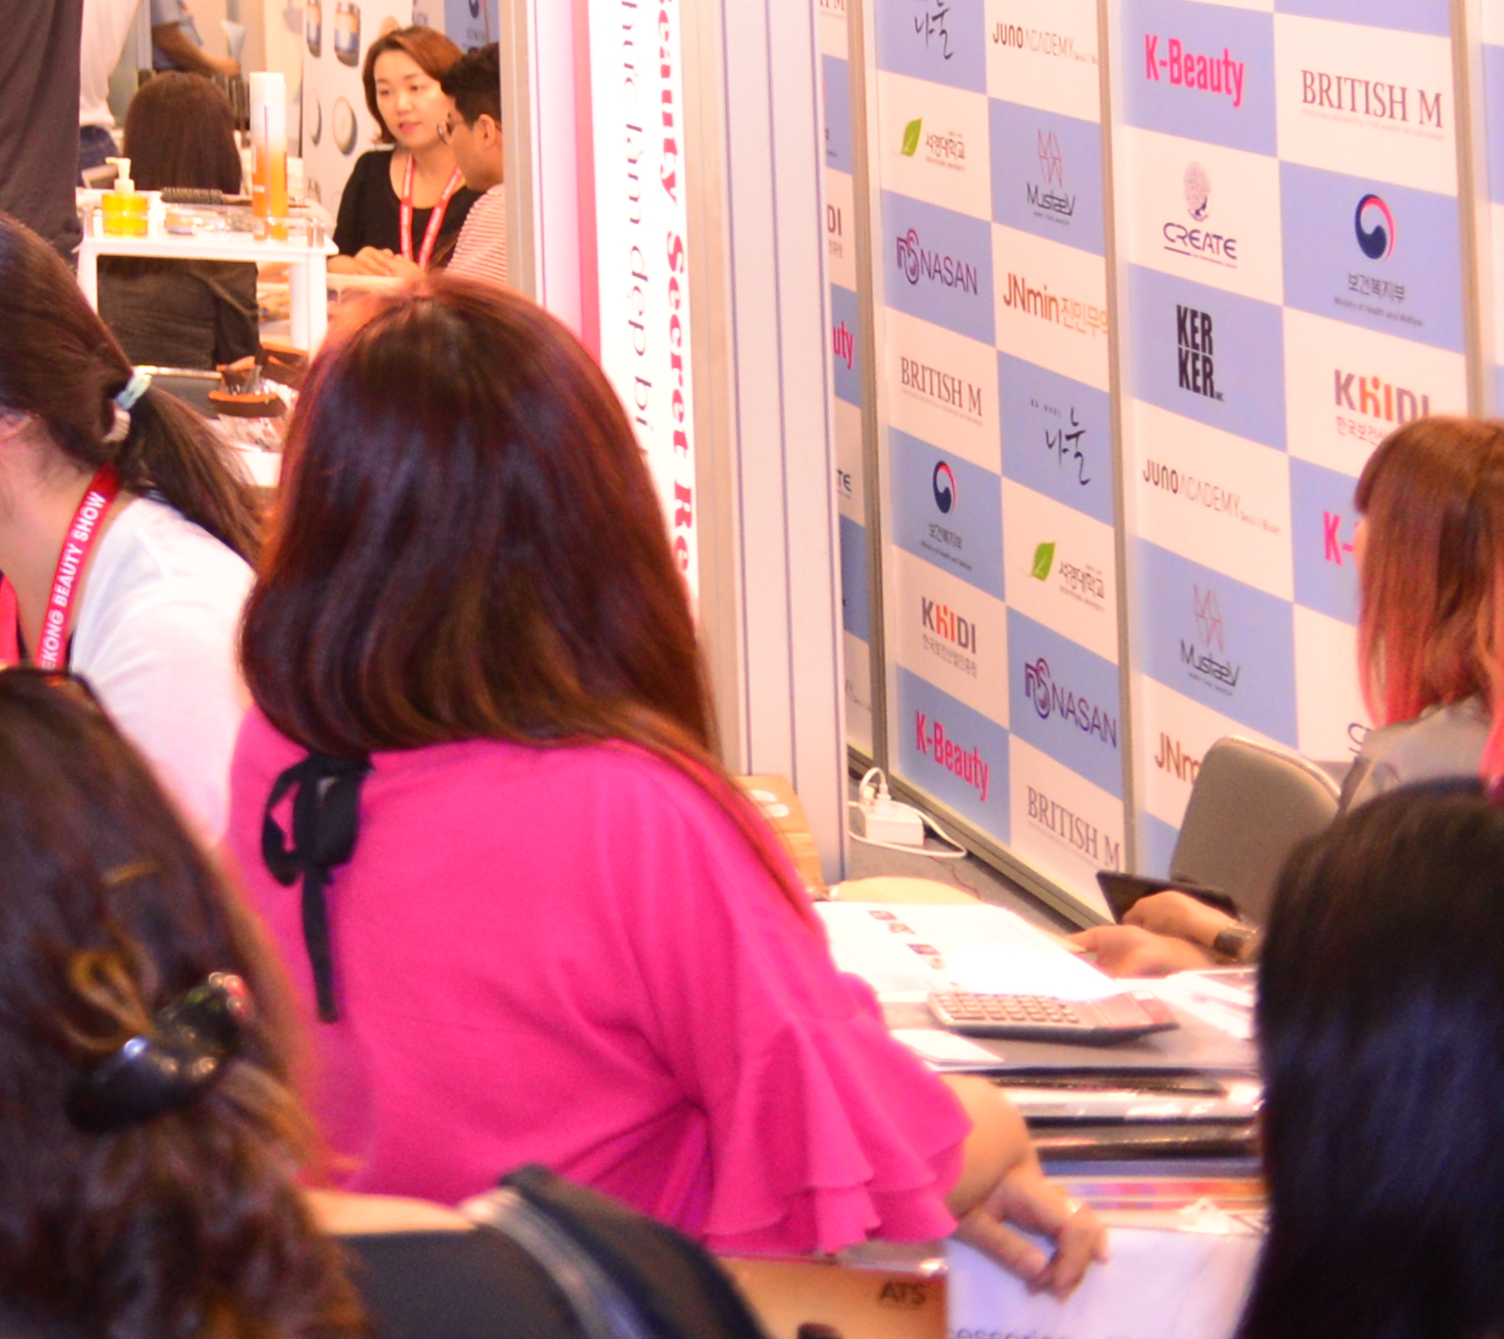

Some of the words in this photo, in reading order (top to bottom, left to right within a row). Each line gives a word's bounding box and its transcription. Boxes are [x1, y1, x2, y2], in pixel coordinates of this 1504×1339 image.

[1145, 33, 1245, 107] K-Beauty
[1302, 69, 1407, 121] BRITISH
[1419, 89, 1443, 129] M
[1163, 222, 1237, 260] CREATE
[920, 252, 978, 296] NASAN
[1003, 273, 1061, 324] JNmin
[667, 231, 689, 458] Secret
[1176, 304, 1213, 356] KER
[900, 356, 963, 408] BRITISH
[968, 388, 983, 417] M
[1178, 347, 1215, 399] KER
[54, 543, 83, 607] BEAUTY
[74, 491, 107, 543] SHOW
[1051, 685, 1118, 748] NASAN
[915, 710, 989, 802] K-Beauty
[1027, 786, 1098, 861] BRITISH
[1103, 835, 1120, 871] M
